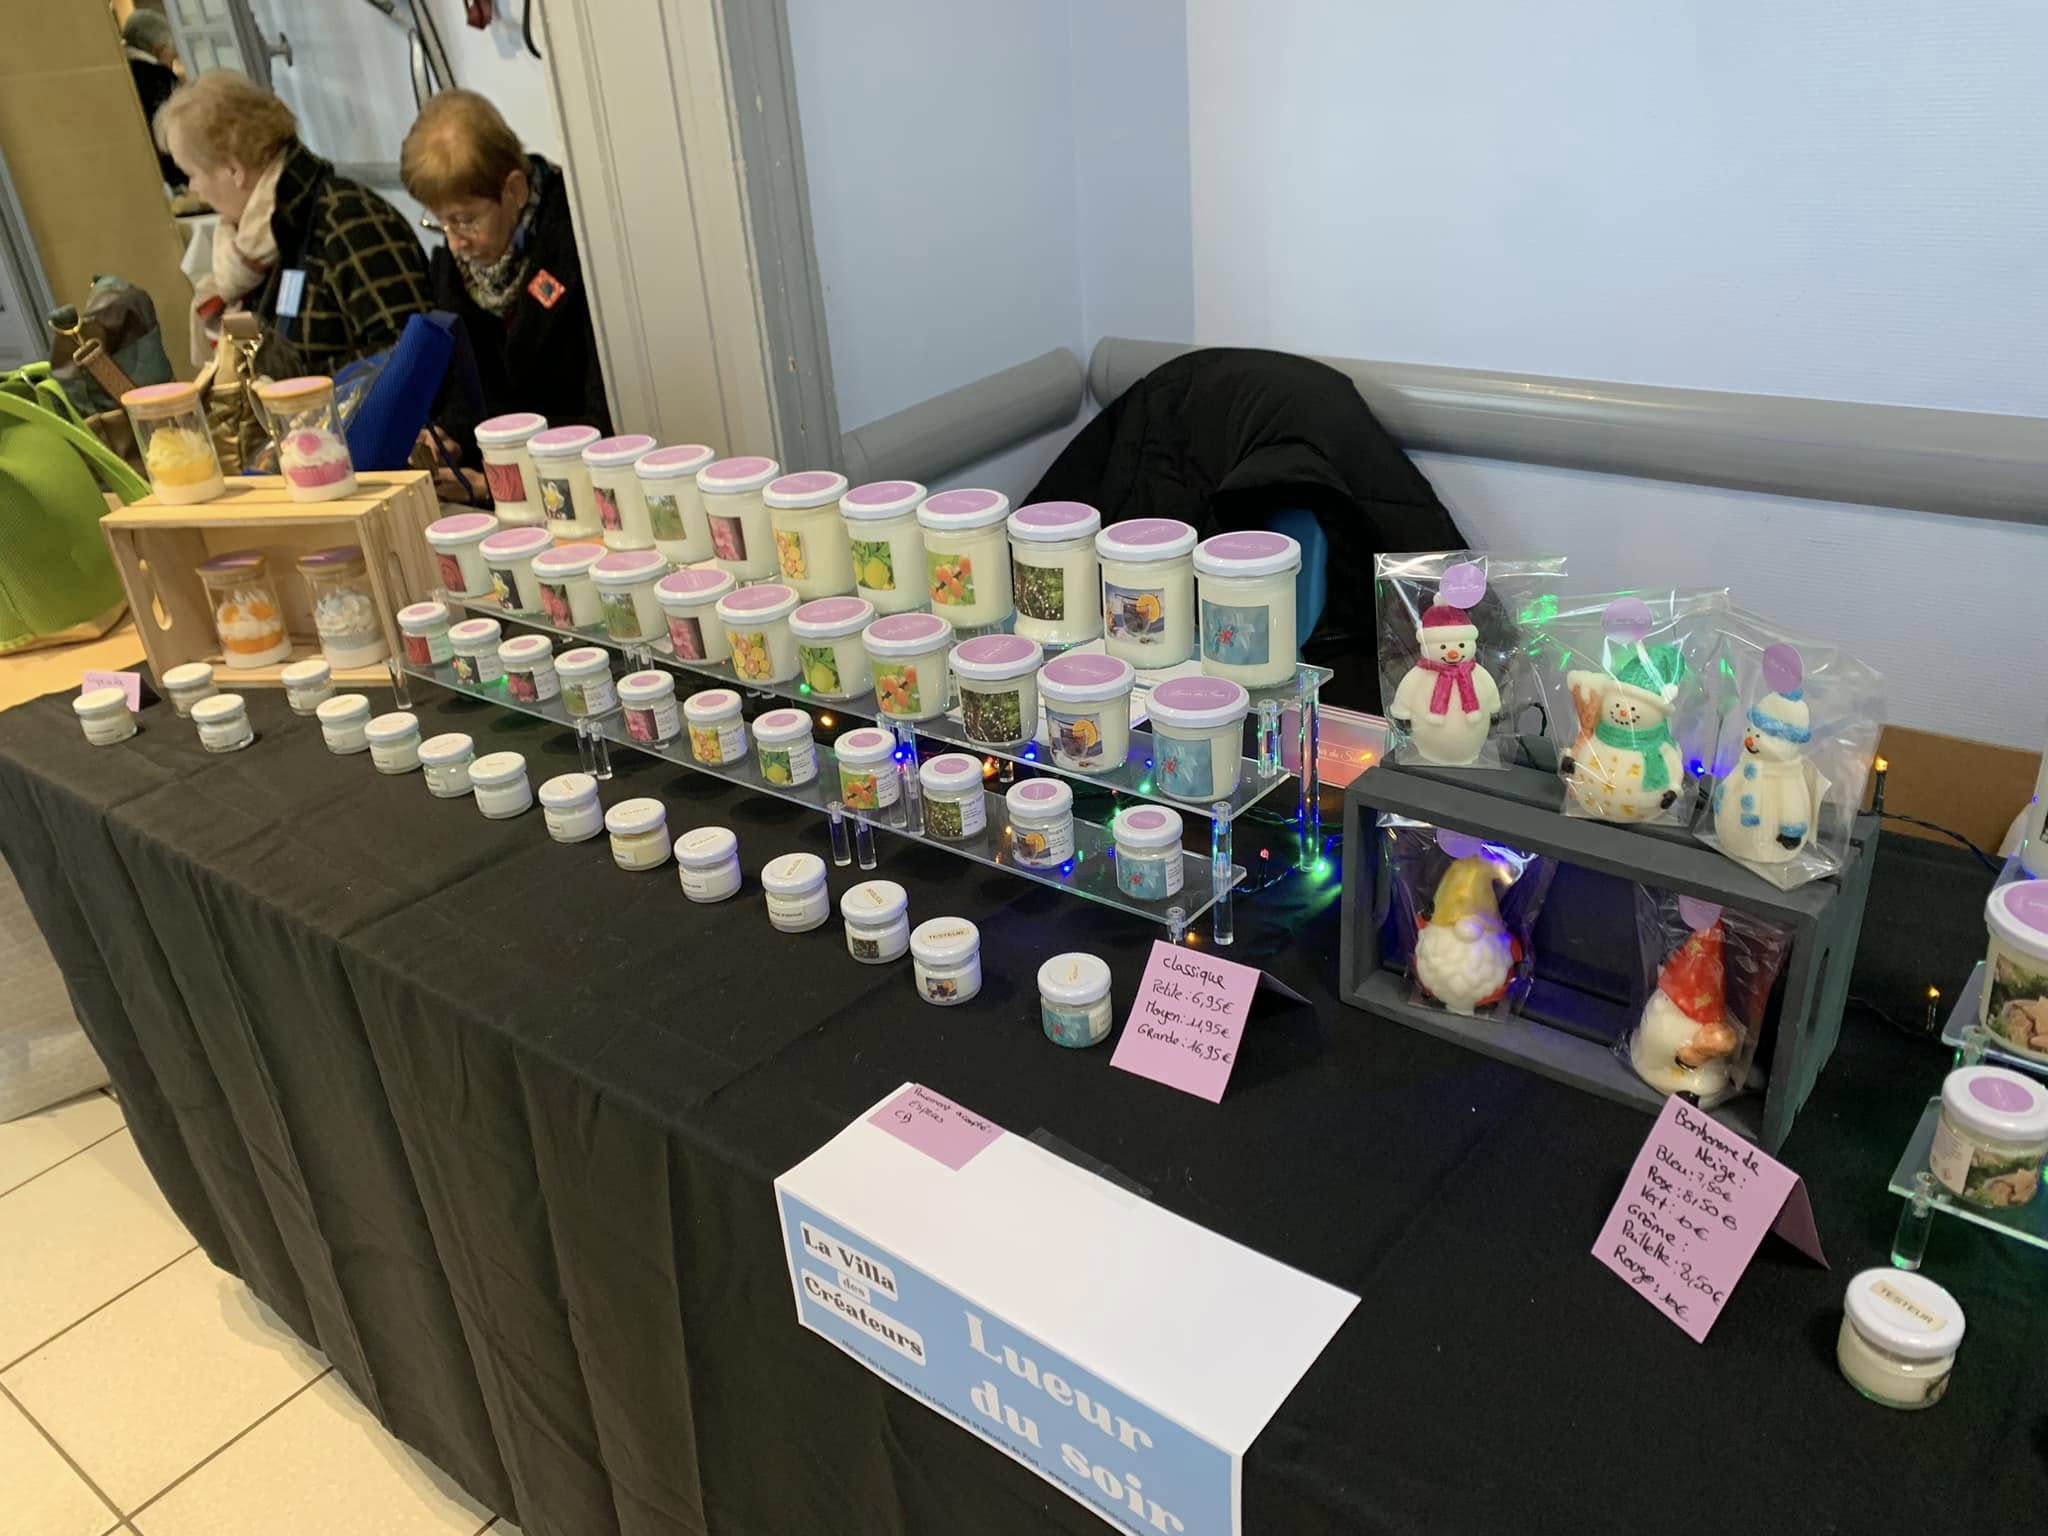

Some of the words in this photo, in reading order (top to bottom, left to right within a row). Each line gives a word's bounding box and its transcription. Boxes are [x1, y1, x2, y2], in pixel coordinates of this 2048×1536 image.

[1191, 991, 1235, 1015] 6,95€
[1742, 1148, 1760, 1177] de
[802, 1226, 831, 1258] La
[838, 1247, 895, 1293] Villa
[842, 1277, 866, 1297] des
[1880, 1287, 1934, 1324] TESTEUR
[804, 1276, 923, 1357] Créateurs
[964, 1311, 1153, 1452] Lueur
[970, 1380, 1043, 1448] du
[1061, 1442, 1185, 1535] soir
